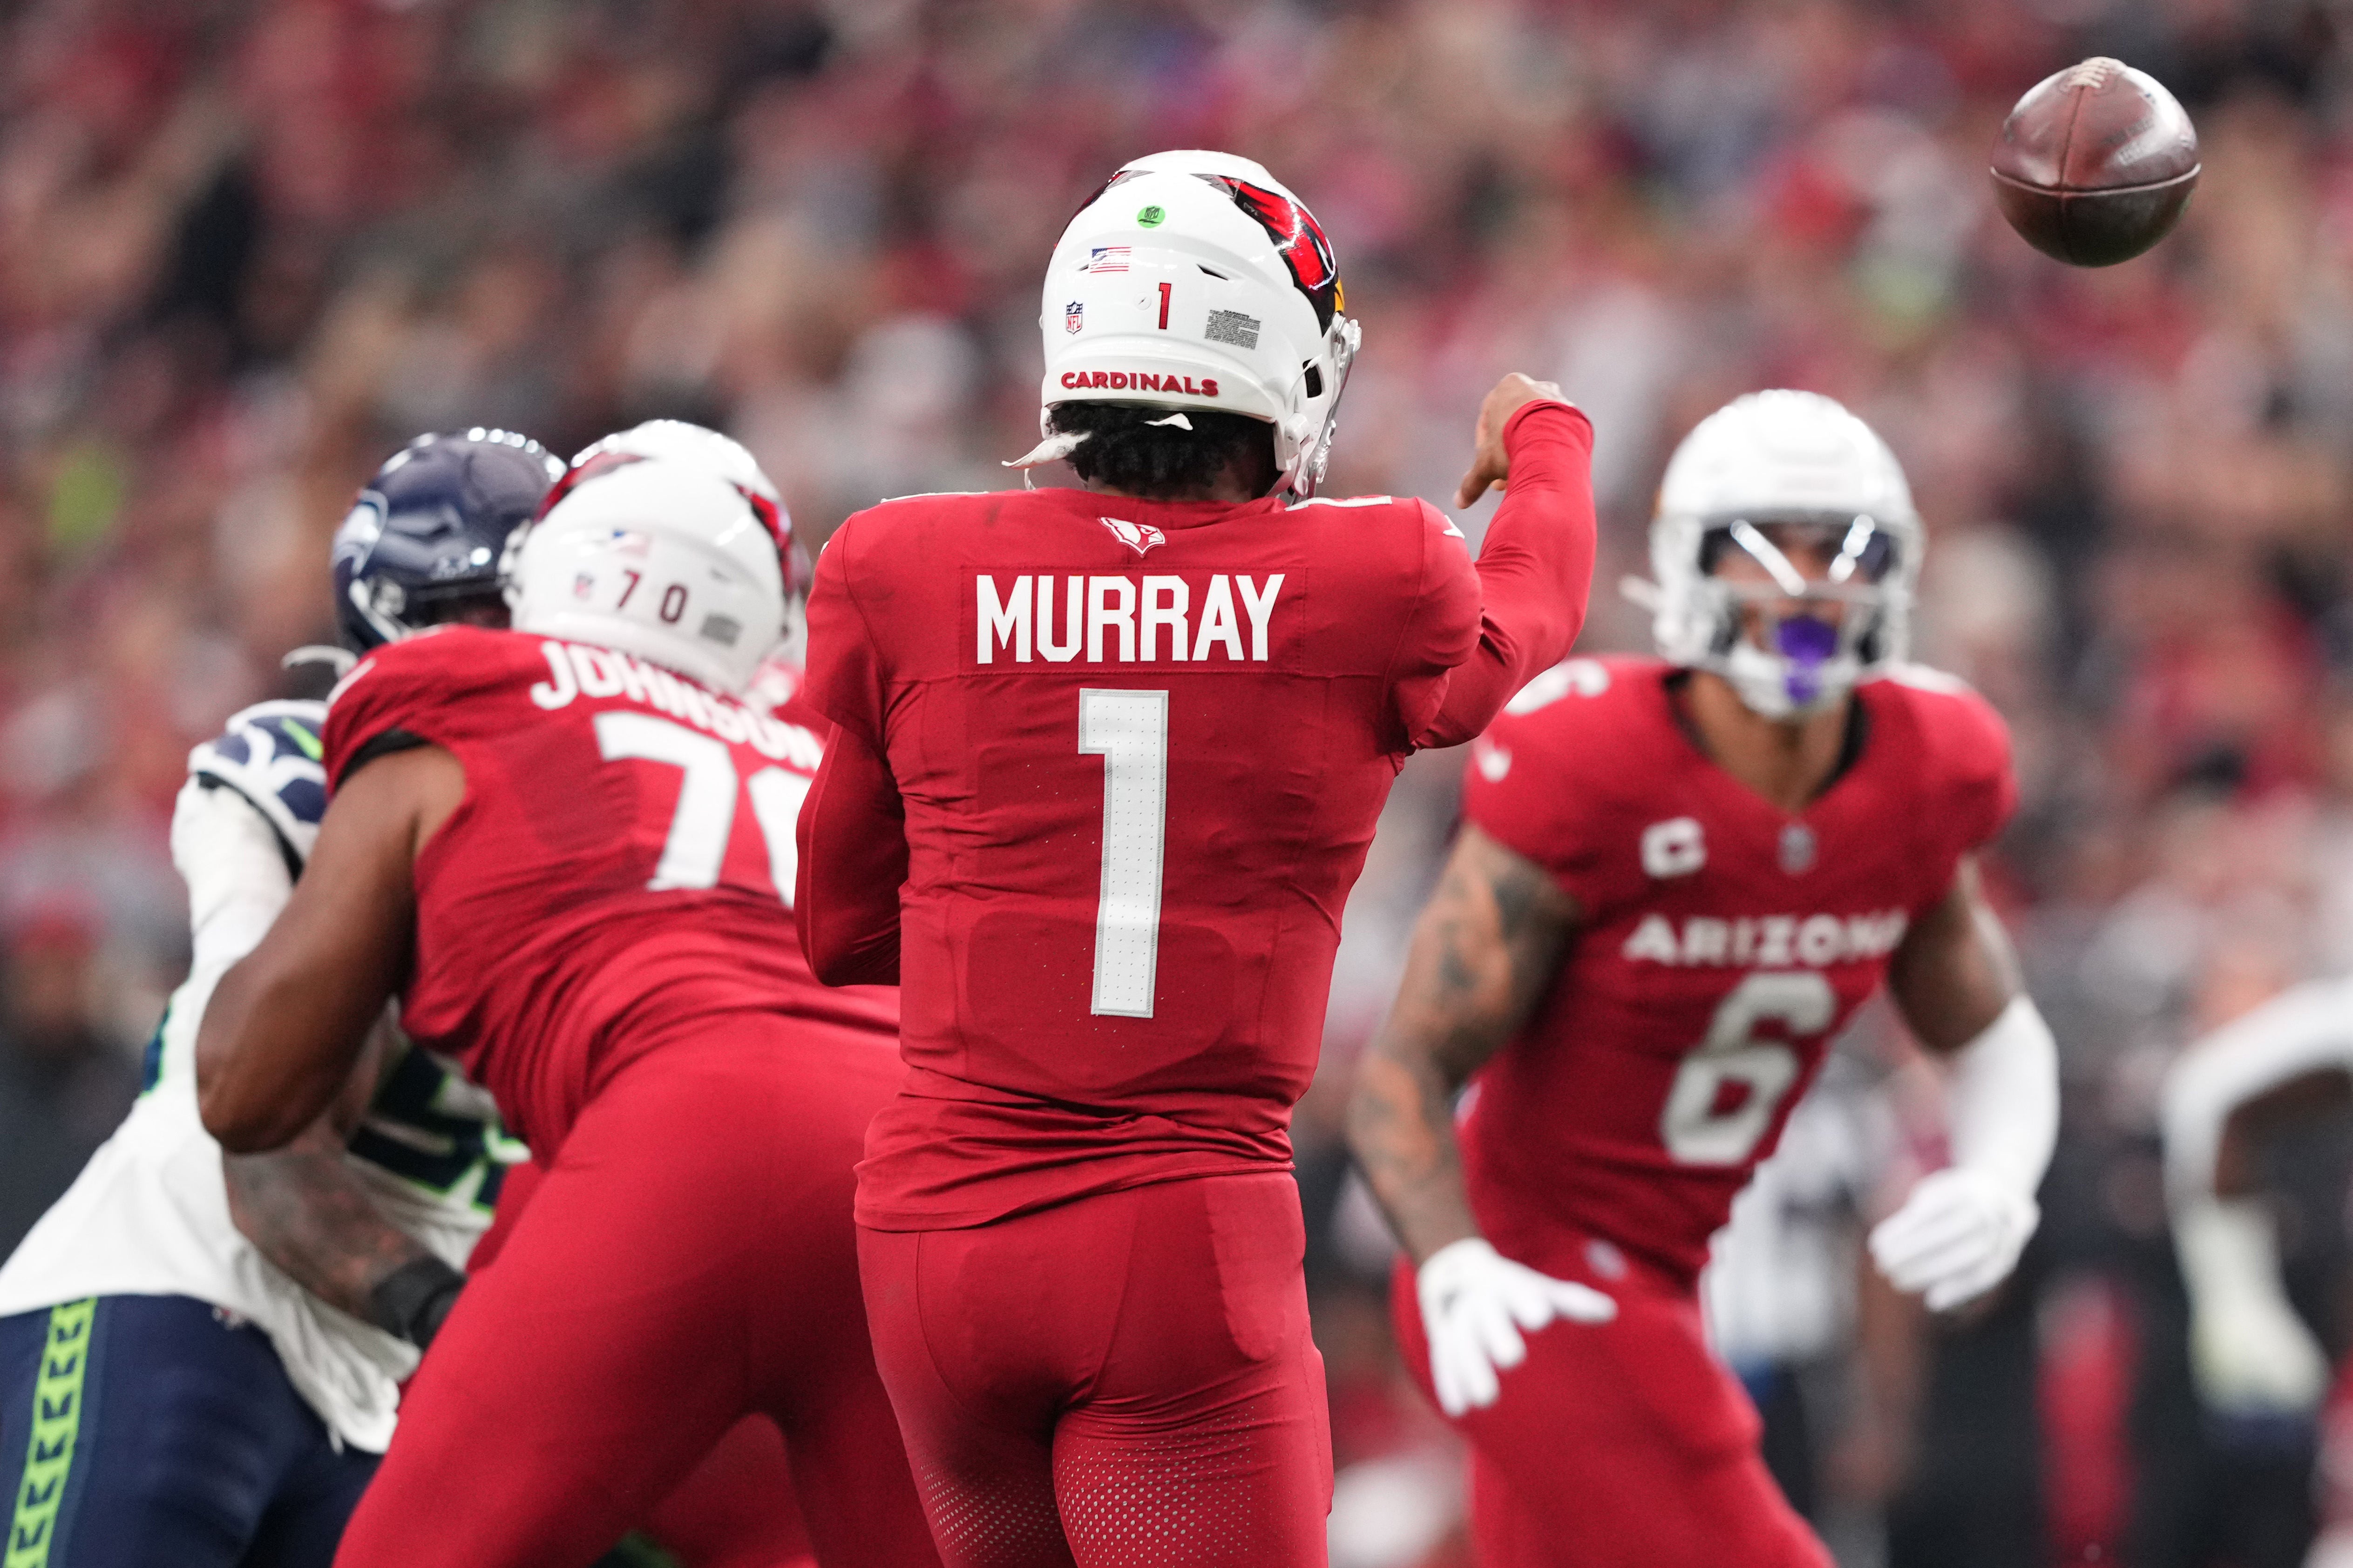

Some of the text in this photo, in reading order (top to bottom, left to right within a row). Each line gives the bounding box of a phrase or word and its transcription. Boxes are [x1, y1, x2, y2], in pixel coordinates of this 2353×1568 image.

[1066, 315, 1081, 331] NFL
[1159, 282, 1171, 330] 1
[1061, 372, 1219, 398] CARDINALS
[615, 568, 690, 625] 70
[976, 574, 1285, 664] MURRAY
[1078, 688, 1170, 1019] 1
[1661, 969, 1837, 1165] 6
